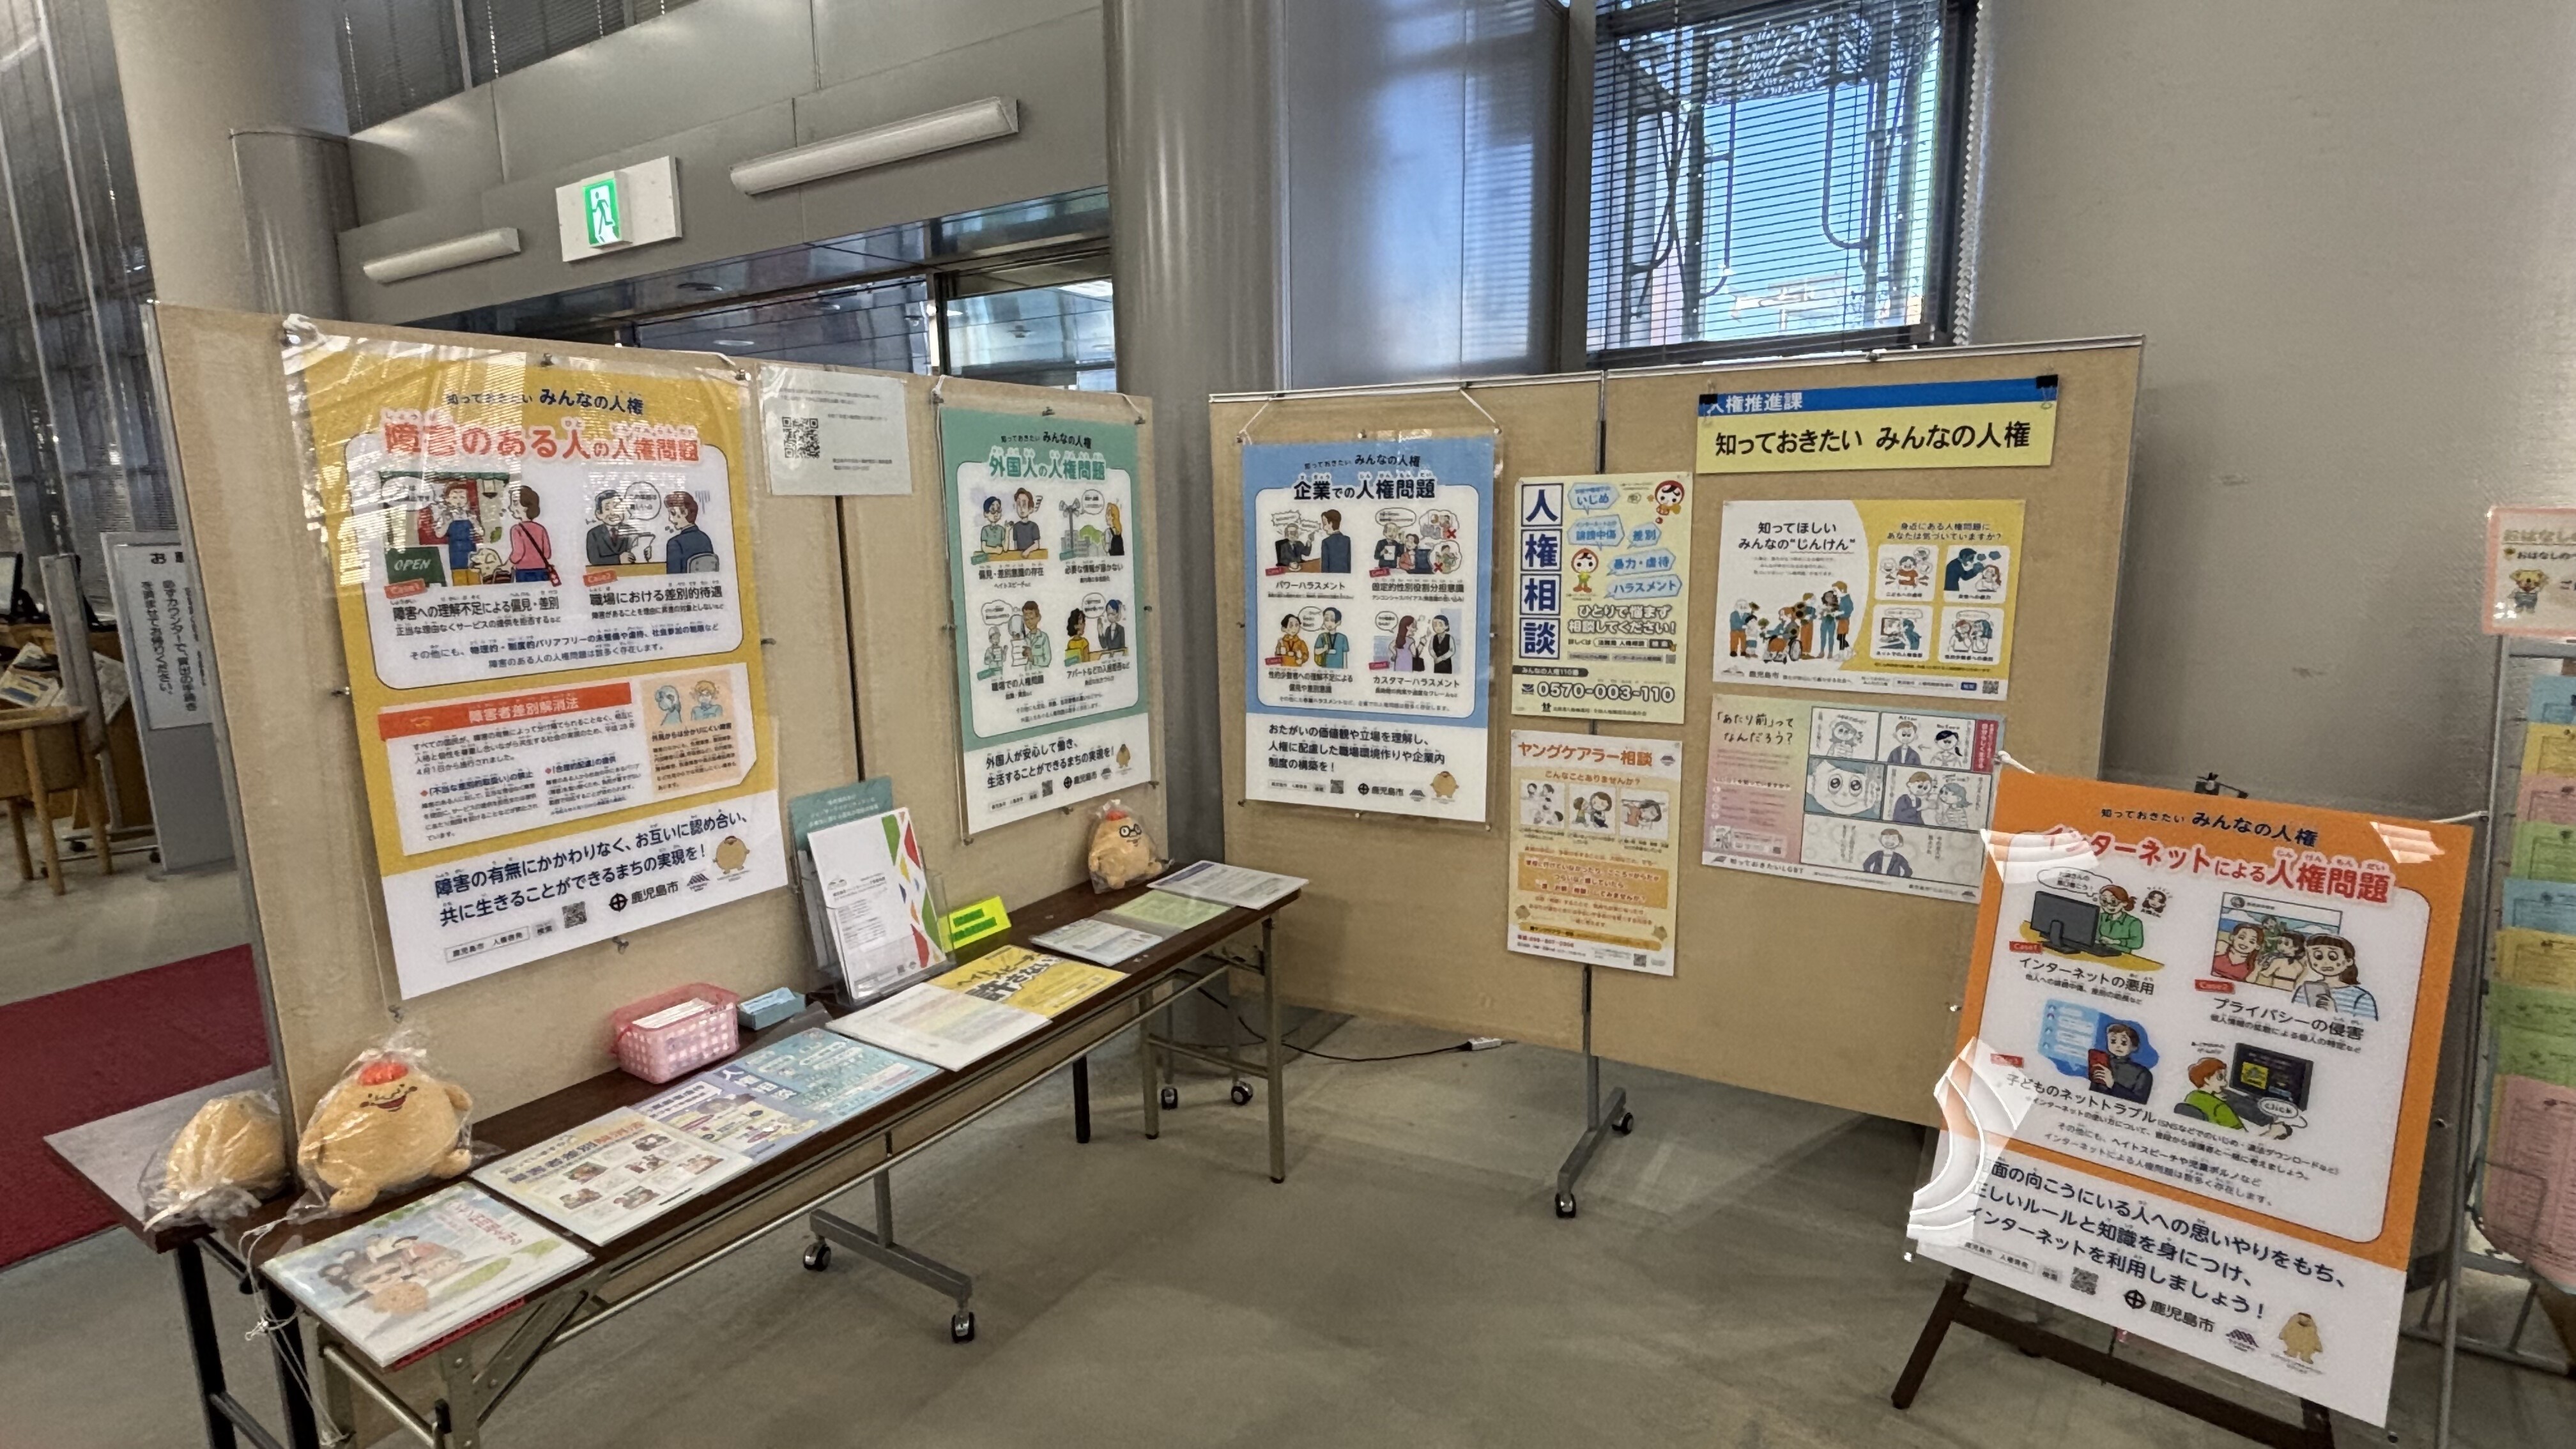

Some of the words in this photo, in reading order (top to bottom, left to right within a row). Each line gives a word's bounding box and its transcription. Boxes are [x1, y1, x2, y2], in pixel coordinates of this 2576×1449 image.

[539, 388, 644, 415] みんなの人権
[1707, 392, 1803, 415] 人権推進課
[385, 422, 700, 463] 障害のある人の人権問題
[1042, 431, 1092, 449] みんなの人権
[1715, 428, 1862, 457] 知っておきたい
[1875, 420, 2031, 450] みんなの人権
[990, 454, 1106, 480] 外国人の人権問題
[1304, 459, 1353, 470] 知っておきたい
[1354, 454, 1421, 468] みんなの人権
[1294, 478, 1436, 500] 企業での人権問題
[1577, 493, 1610, 505] いじめ
[1632, 529, 1657, 542] 差別
[1758, 521, 1837, 535] 知ってほしい
[1901, 521, 1990, 532] 身近にある人権問題に
[394, 558, 432, 571] OPEN
[1523, 489, 1560, 655] 人権相談
[1613, 556, 1670, 570] 暴力・虐待
[590, 585, 723, 606] 職場における差別的待遇
[1275, 581, 1346, 590] パワーハラスメント
[1613, 581, 1678, 594] ハラスメント
[393, 596, 559, 622] 障害への理解不足による偏見・差別
[1577, 604, 1673, 620] ひとりで悩まず
[1372, 675, 1460, 689] カスタマーハラスメント
[1521, 666, 1579, 677] みんなの人権110番
[1748, 670, 1780, 680] 鹿児島市
[1537, 680, 1675, 703] 0570-003-110
[468, 697, 579, 724] 障害者差別解消法
[1269, 723, 1429, 745] おたがいの価値観や立場を理解し、
[1268, 740, 1446, 765] 人権に配慮した職場環境作りや企業内
[1518, 742, 1653, 767] ヤングケアラー相談
[1371, 786, 1404, 797] 鹿児島市
[2100, 808, 2186, 824] 知っておきたい
[2191, 811, 2319, 847] みんなの人権
[2045, 826, 2391, 905] インターネットによる人権問題
[631, 880, 678, 905] 鹿児島市
[2020, 957, 2155, 995] インターネットの悪用
[2214, 997, 2365, 1041] プライバシーの侵害
[2006, 1073, 2157, 1123] 子どものネットトラブル
[2150, 1300, 2215, 1333] 鹿児島市
